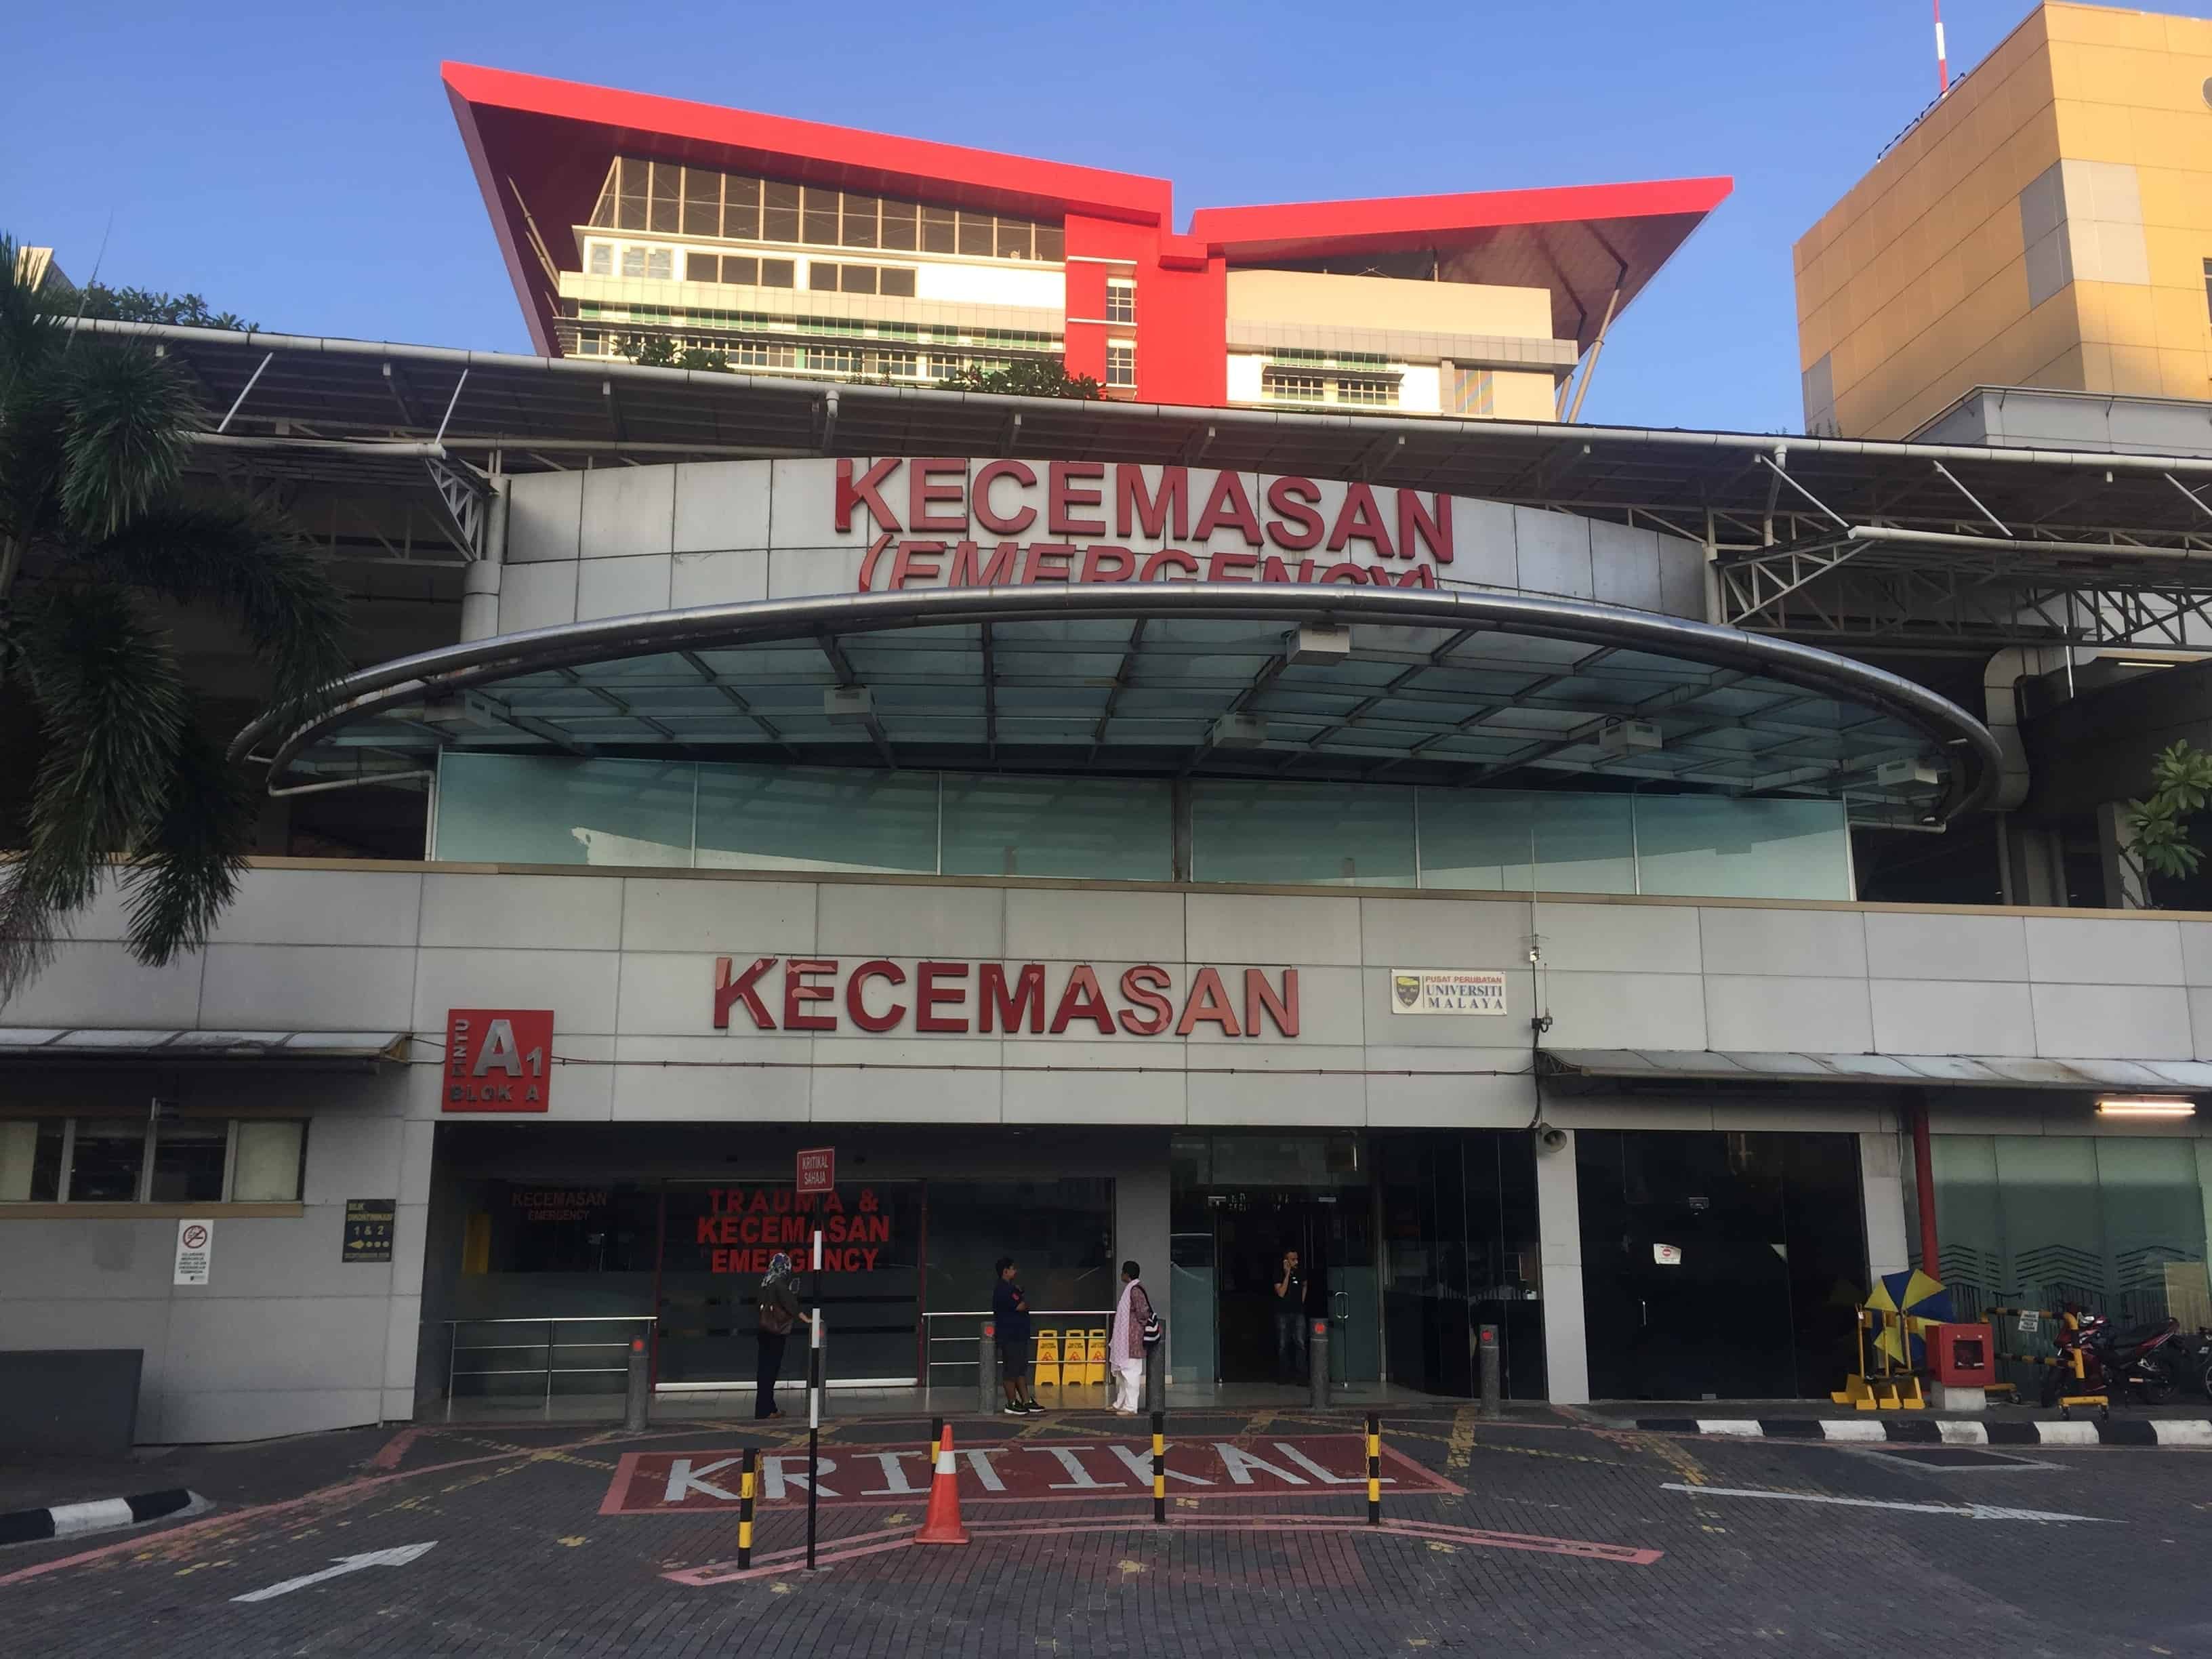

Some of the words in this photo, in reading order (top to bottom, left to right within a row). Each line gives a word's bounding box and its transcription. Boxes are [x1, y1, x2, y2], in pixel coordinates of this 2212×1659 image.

[834, 457, 1454, 564] KECEMASAN
[713, 957, 1298, 1036] KECEMASAN
[1426, 984, 1502, 997] UNIVERSITI
[1428, 998, 1503, 1009] MALAYA
[451, 1019, 469, 1078] PINTU
[450, 1084, 514, 1102] BLOK
[525, 1084, 540, 1102] A
[802, 1154, 829, 1170] KRITIKAL
[804, 1170, 826, 1185] SAHAJA
[512, 1192, 607, 1207] KECEMASAN
[707, 1188, 844, 1213] TRAUMA
[857, 1187, 879, 1213] &
[377, 1225, 384, 1235] 2
[696, 1215, 889, 1244] KECEMASAN
[664, 1441, 1397, 1501] KRITIKAL
